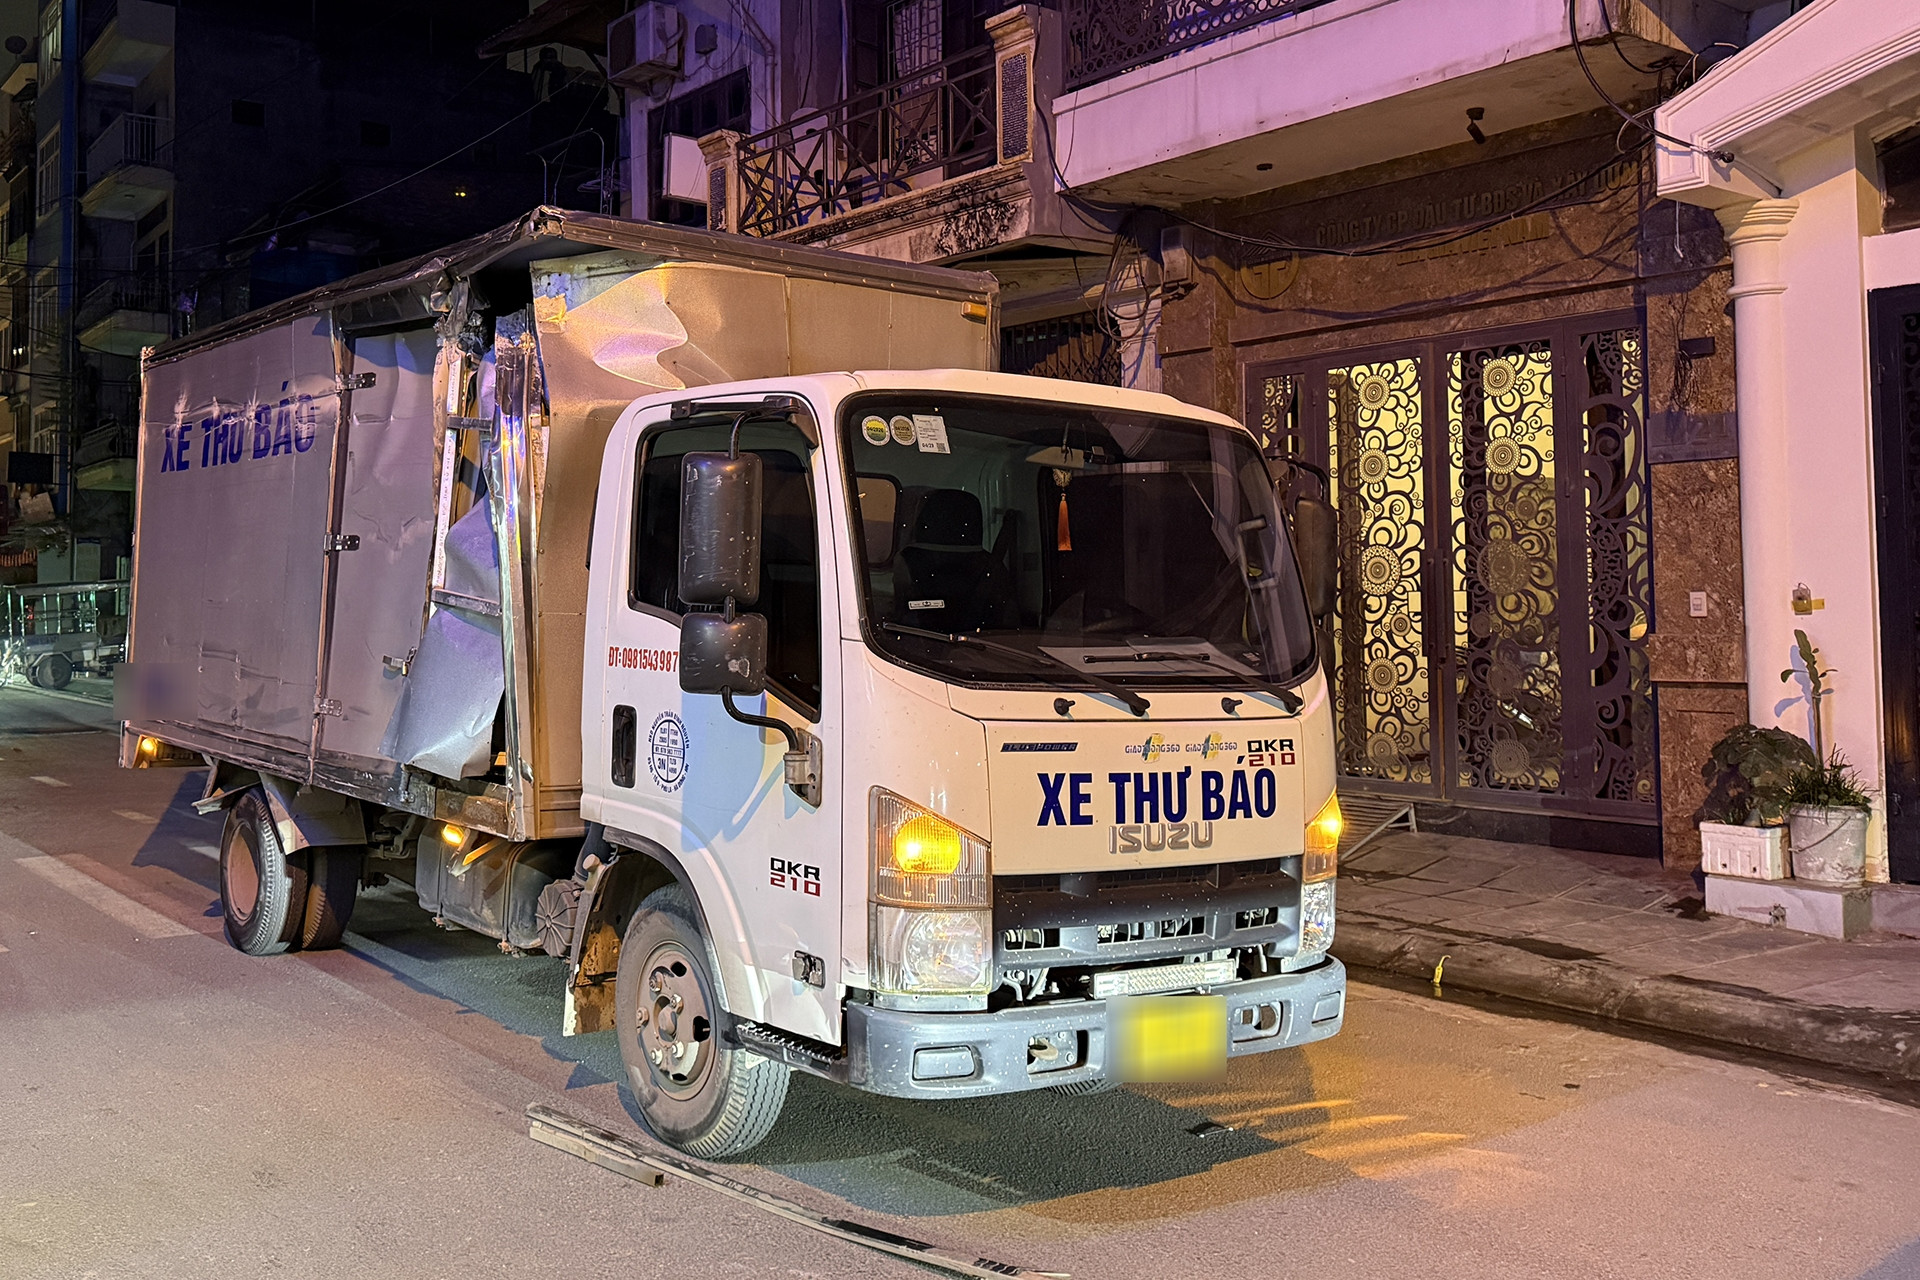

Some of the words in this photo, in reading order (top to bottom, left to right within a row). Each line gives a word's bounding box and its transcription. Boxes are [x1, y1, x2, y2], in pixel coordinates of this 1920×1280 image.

[1316, 219, 1361, 247] CÔNG
[1363, 215, 1382, 239] TY
[161, 420, 193, 473] XE
[252, 381, 317, 460] BÁO
[608, 646, 679, 672] ĐT:0981543987
[1247, 739, 1295, 752] QKR
[1249, 753, 1296, 767] 210
[1037, 773, 1093, 826] XE
[1108, 766, 1192, 824] THƯ
[1202, 756, 1276, 821] BÁO
[1109, 821, 1213, 854] ISUZU
[770, 857, 821, 881] QKR
[770, 872, 820, 897] 210
